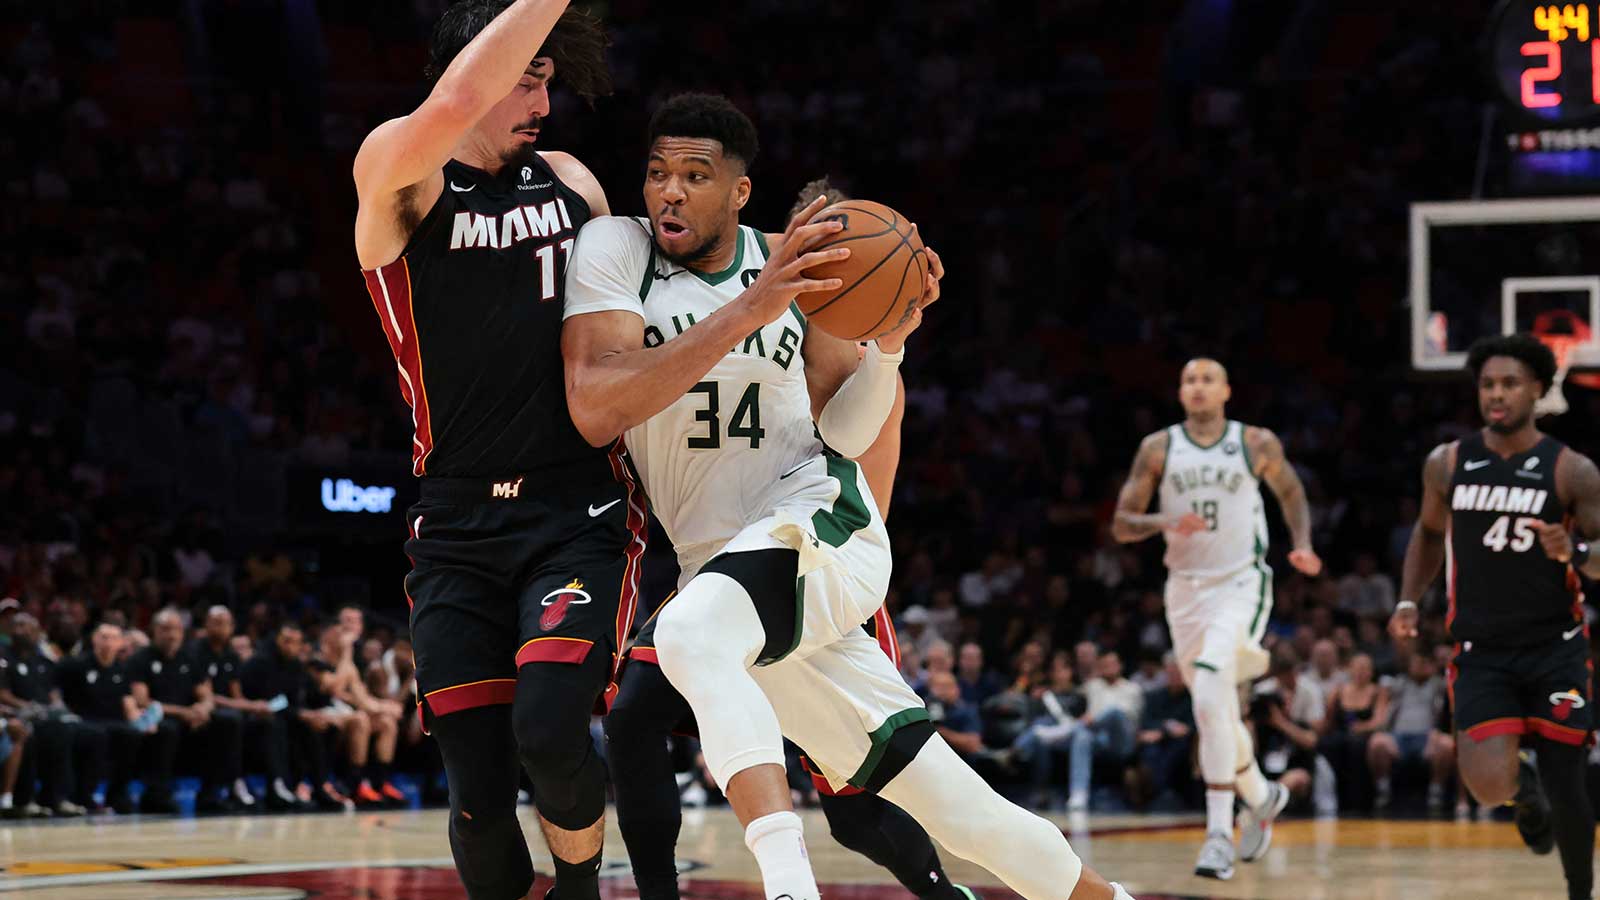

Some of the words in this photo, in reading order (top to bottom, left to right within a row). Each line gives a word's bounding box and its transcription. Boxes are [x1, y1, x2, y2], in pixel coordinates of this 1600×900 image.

[449, 196, 573, 249] MIAMI
[688, 380, 766, 449] 34
[321, 478, 395, 513] Uber
[1451, 484, 1548, 515] MIAMI
[1482, 515, 1535, 552] 45
